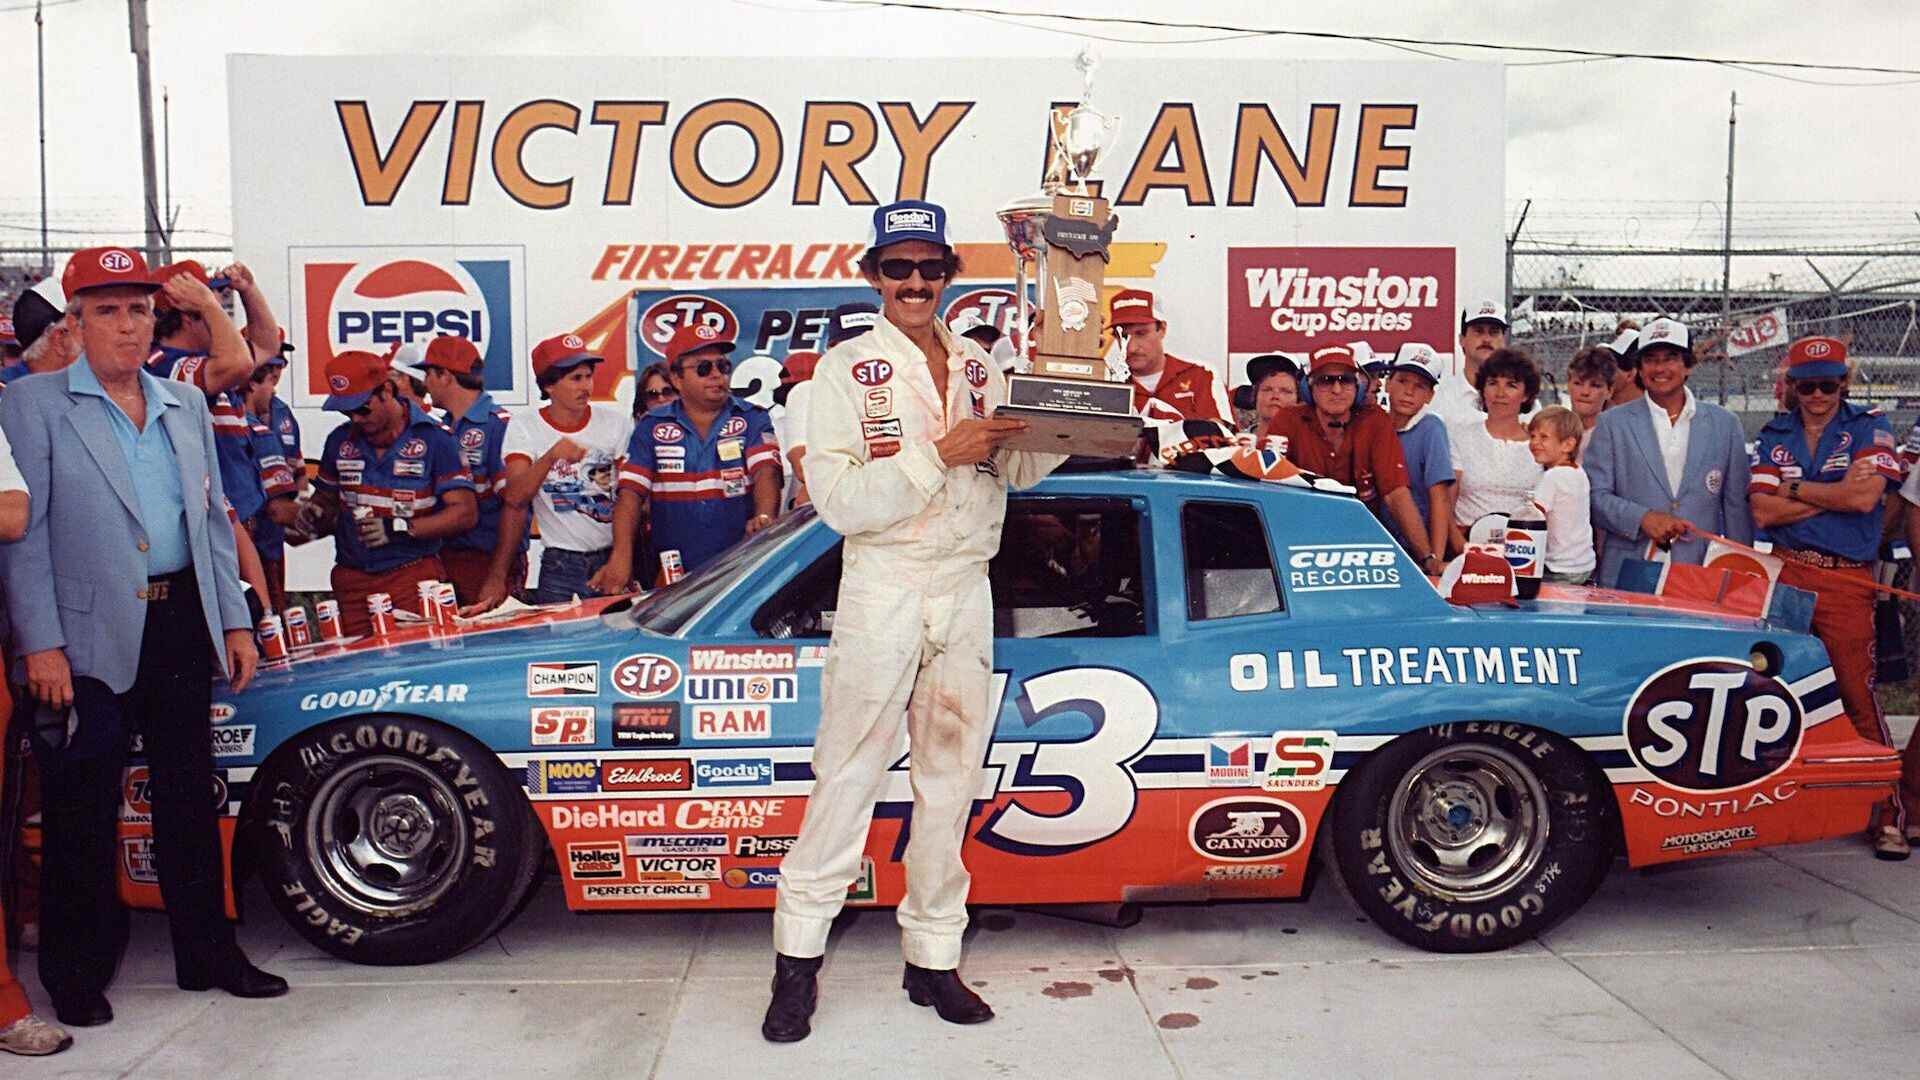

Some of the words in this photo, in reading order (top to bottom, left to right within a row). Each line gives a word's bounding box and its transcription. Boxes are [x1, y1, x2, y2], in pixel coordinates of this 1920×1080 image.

[335, 99, 975, 207] VICTORY
[1041, 100, 1417, 207] LANE
[103, 253, 130, 270] STP
[591, 243, 872, 280] FIRECRACK
[1246, 267, 1438, 308] Winston
[338, 309, 482, 344] PEPSI
[1270, 308, 1327, 337] Cup
[1328, 307, 1413, 332] Series
[856, 361, 891, 383] STP
[966, 361, 987, 384] STP
[656, 425, 682, 439] STP
[1289, 551, 1396, 568] CURB
[1290, 569, 1400, 586] RECORDS
[1461, 573, 1506, 584] Winston
[692, 649, 794, 671] Winston
[1229, 649, 1338, 692] OIL
[1342, 646, 1582, 687] TREATMENT
[533, 672, 594, 686] CHAMPION
[620, 658, 673, 690] STP
[301, 680, 469, 711] GOODYEAR
[617, 707, 673, 726] TRW
[699, 710, 766, 733] RAM
[1640, 671, 1791, 776] STP
[1464, 723, 1555, 759] EAGLE
[548, 762, 597, 779] MOOG
[607, 767, 683, 785] Edelbrock
[697, 763, 771, 782] Goody's
[1209, 767, 1249, 778] MODINE
[1266, 778, 1321, 788] SAUNDERS
[330, 724, 498, 869] GOODYEAR
[1629, 781, 1799, 818] PONTIAC
[552, 803, 665, 829] DieHard
[675, 799, 786, 829] CRANE
[735, 836, 799, 856] RUSS
[1205, 837, 1289, 850] CANNON
[1663, 825, 1757, 847] MOTORSPORTS
[570, 851, 621, 865] Holley
[1683, 842, 1732, 854] DESIGNS
[640, 858, 717, 872] VICTOR
[748, 872, 782, 884] Cha
[1359, 827, 1544, 937] GOODYEAR
[587, 885, 649, 895] PERFECT
[652, 885, 703, 894] CIRCLE
[283, 879, 365, 946] EAGLE
